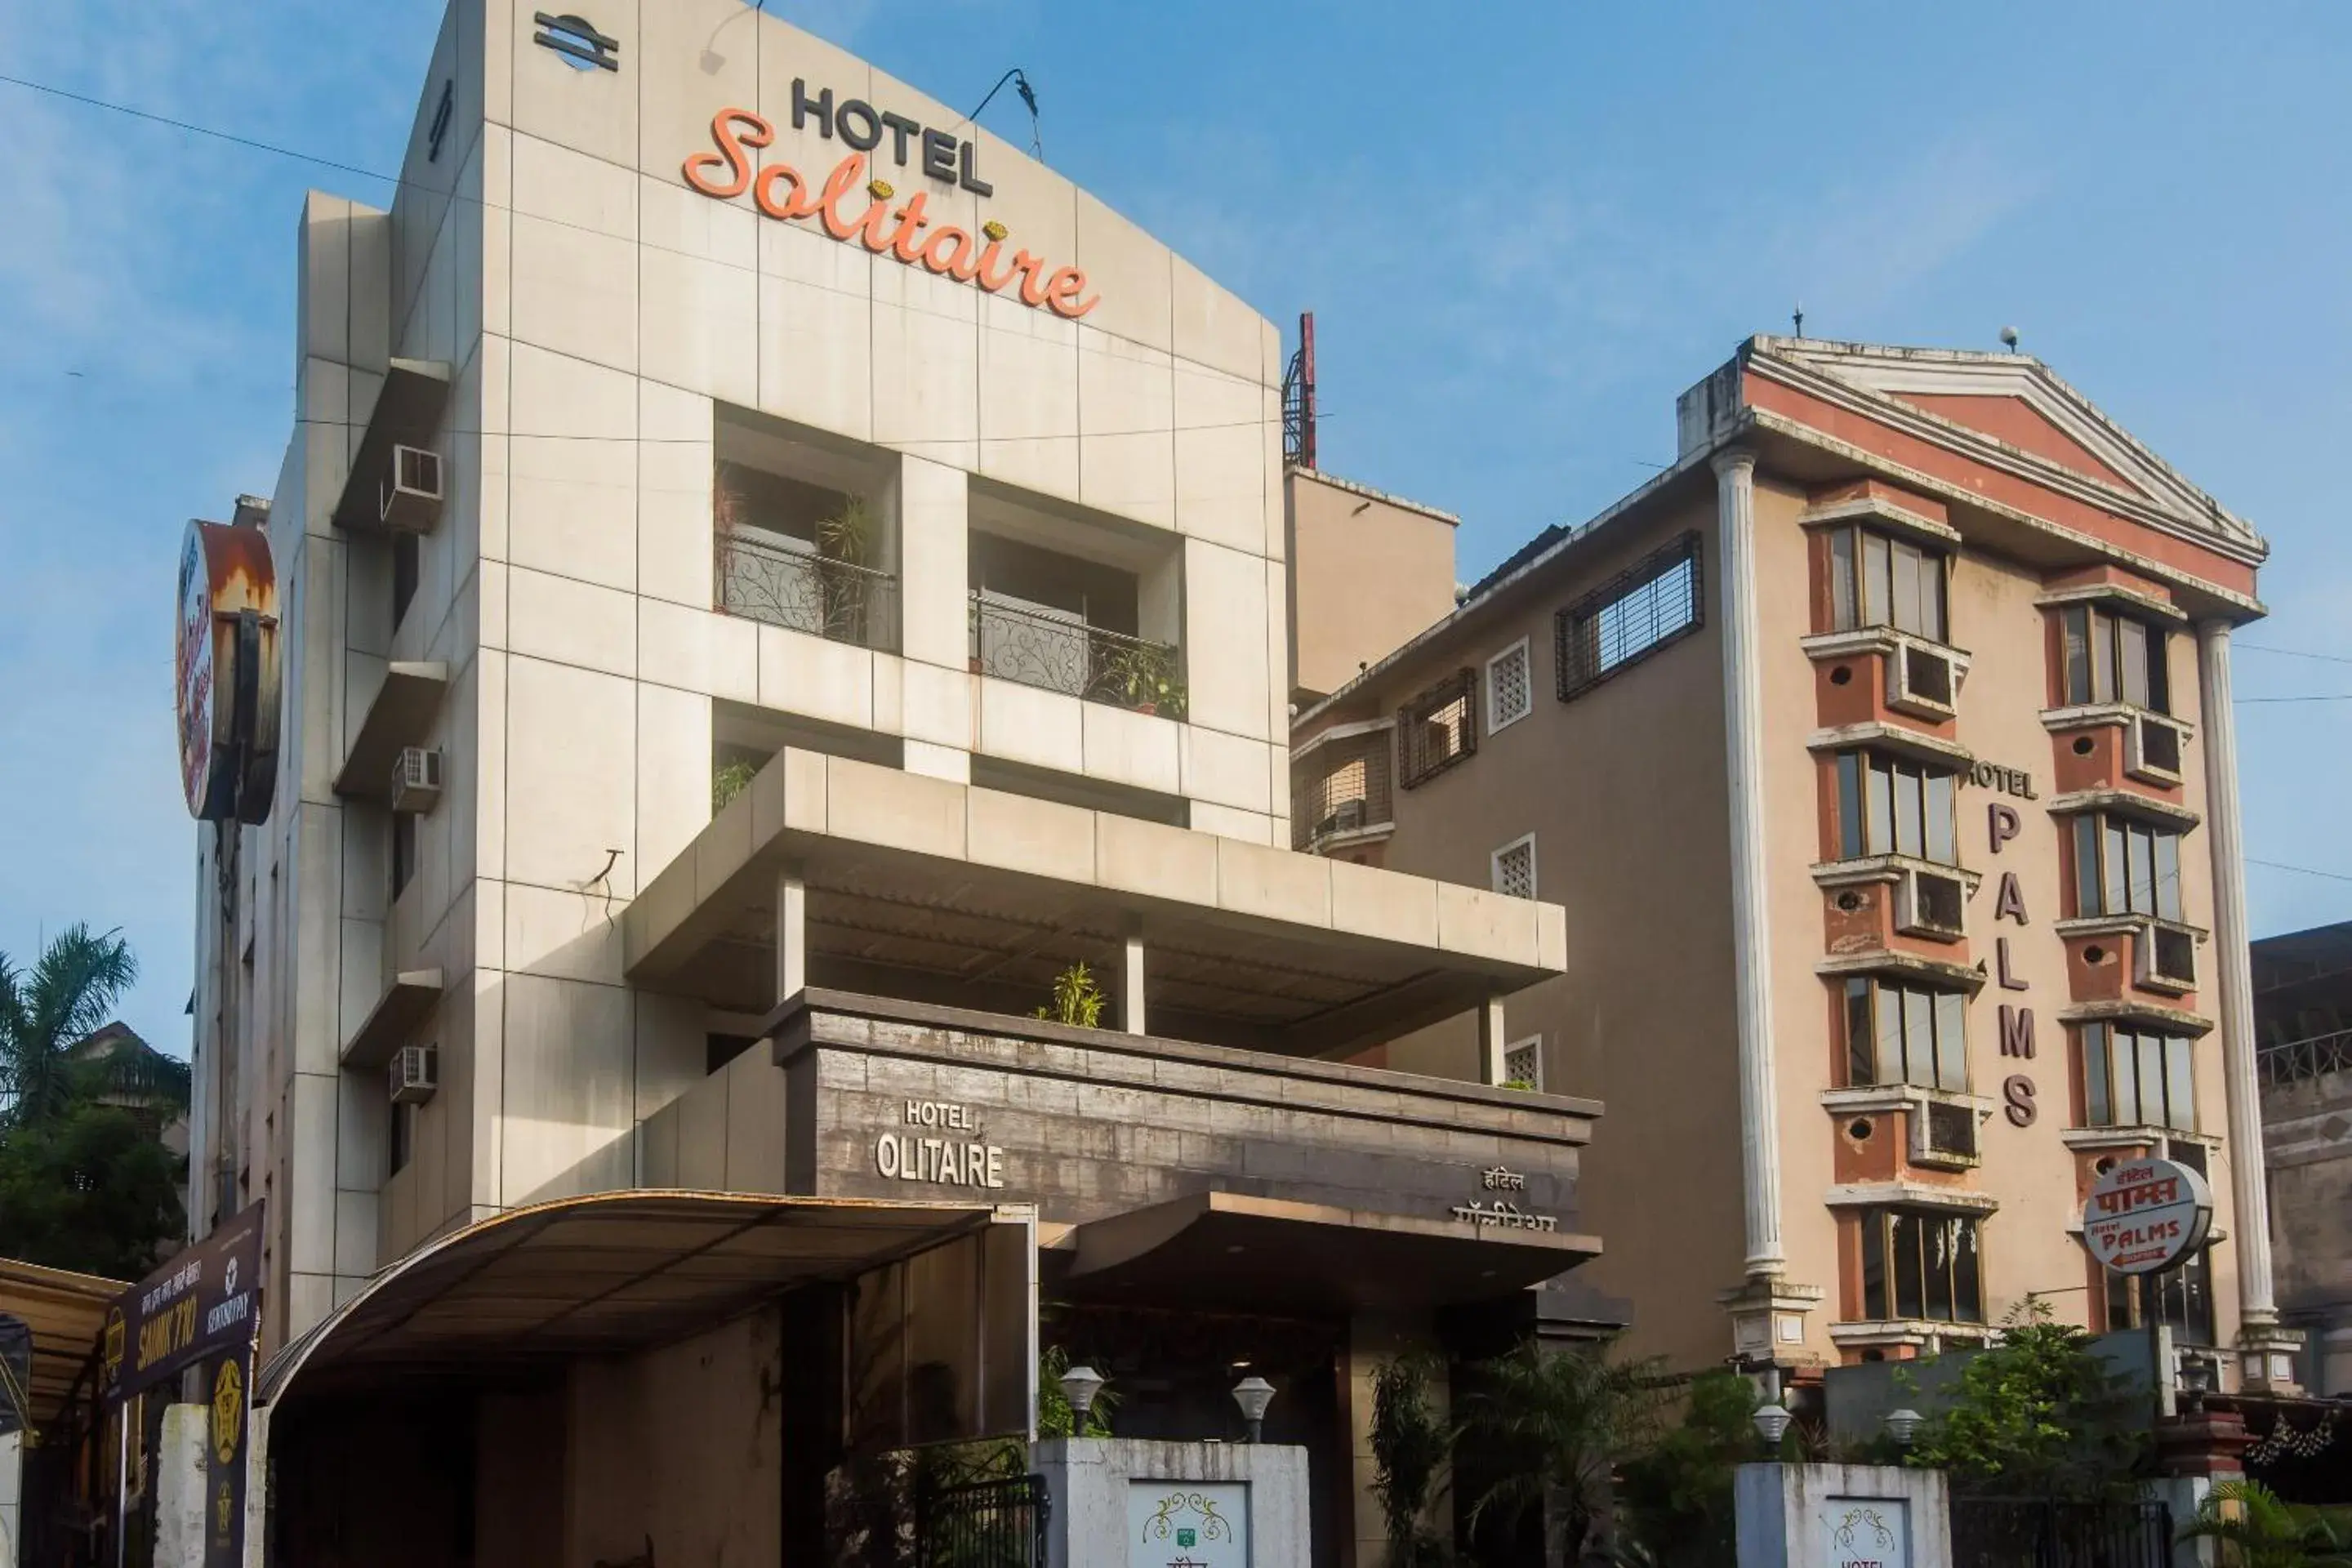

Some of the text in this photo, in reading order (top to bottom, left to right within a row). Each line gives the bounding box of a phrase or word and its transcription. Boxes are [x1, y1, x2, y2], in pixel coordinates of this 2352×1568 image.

[791, 78, 993, 197] HOTEL
[683, 107, 1100, 318] Solitaire
[1987, 803, 2038, 1128] PALMS
[876, 1133, 1004, 1189] OLITAIRE
[905, 1100, 973, 1129] HOTEL
